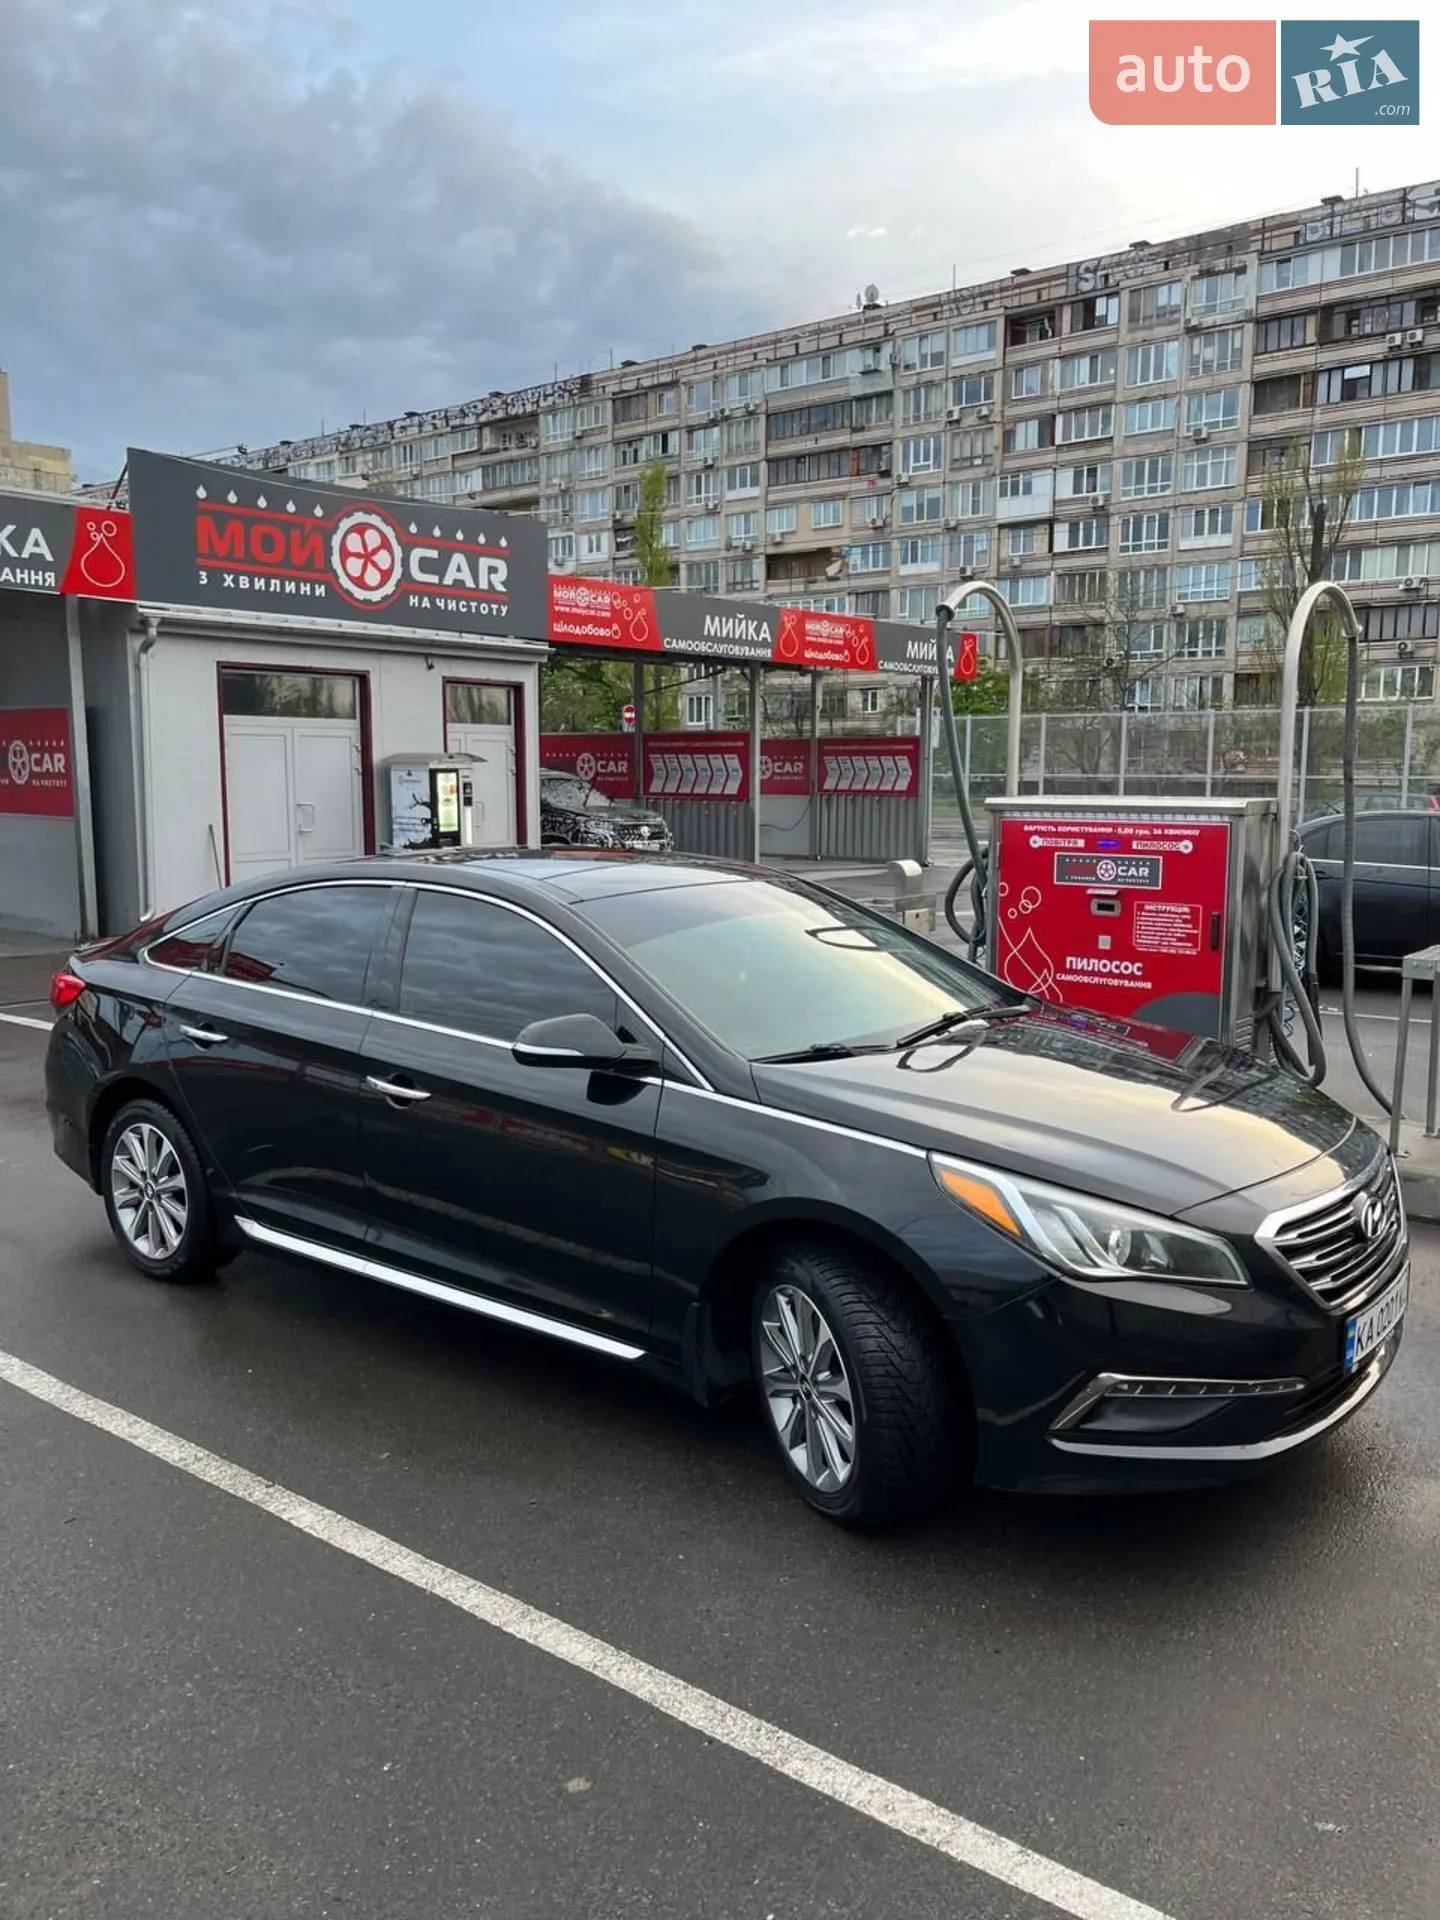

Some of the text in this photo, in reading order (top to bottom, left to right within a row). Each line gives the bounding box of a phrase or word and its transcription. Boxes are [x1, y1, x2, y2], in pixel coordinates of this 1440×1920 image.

[195, 514, 508, 592] МОЙ CAR
[0, 567, 56, 587] АННЯ
[223, 573, 326, 597] ХВИЛИНИ
[409, 595, 508, 616] НА ЧИСТОТУ
[591, 594, 611, 604] CAR
[703, 612, 772, 642] МИЙКА
[663, 637, 772, 658] САМООБСЛУГОВУВАННЯ
[906, 638, 954, 662] МИЙА
[31, 753, 66, 773] CAR
[597, 760, 628, 773] CAR
[773, 762, 804, 773] CAR
[1042, 838, 1078, 847] ПОВІТРЯ
[1136, 841, 1180, 850] ПИЛОСОС
[1117, 866, 1149, 877] CAR
[1065, 956, 1143, 976] ПИЛОСОС
[1056, 973, 1152, 989] САМООБСЛУГОВУВАННЯ
